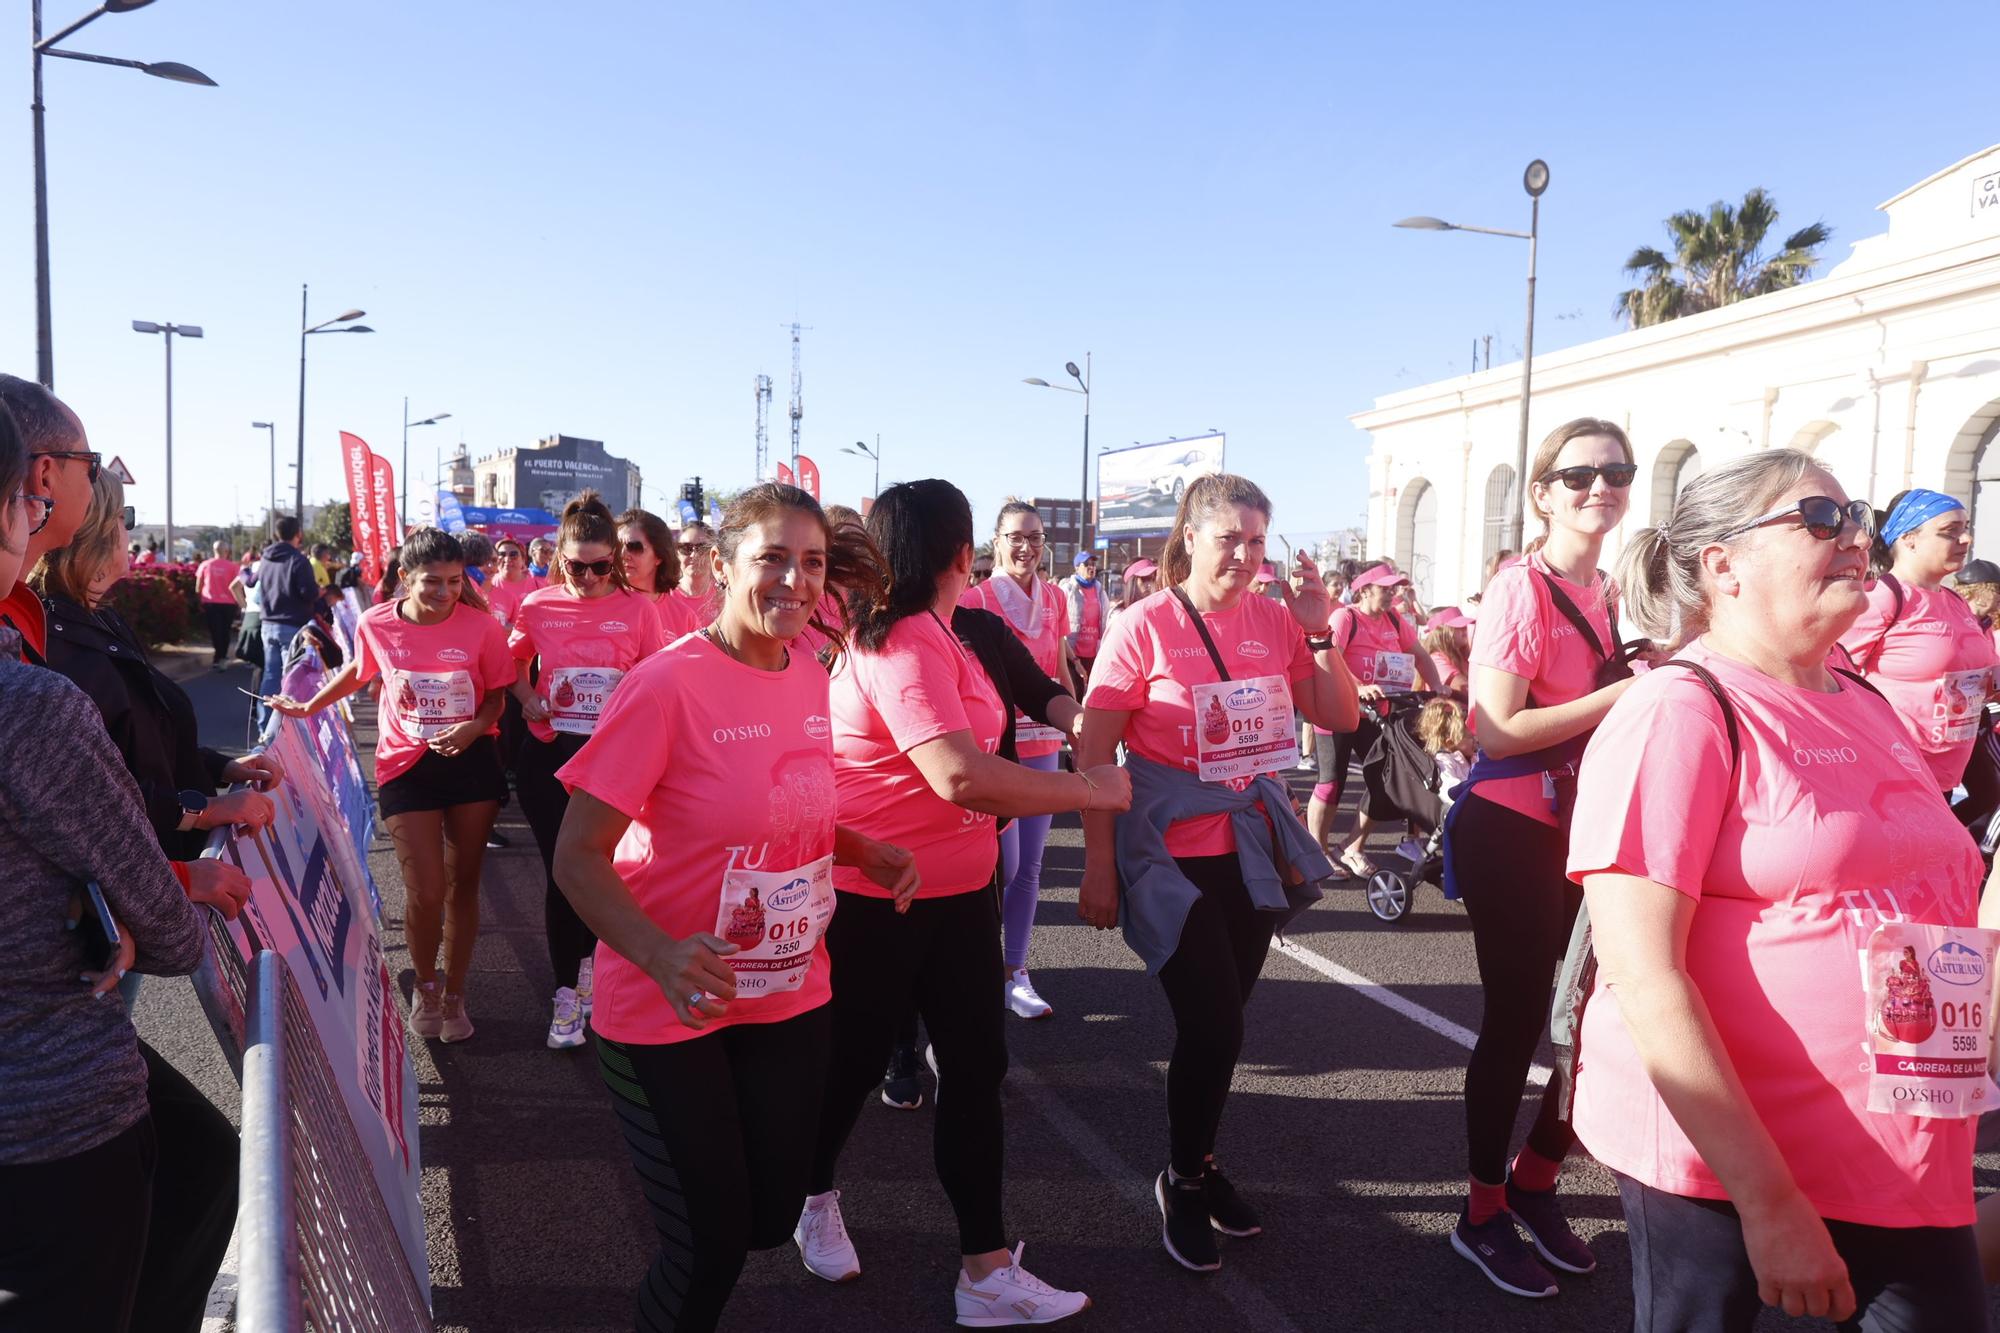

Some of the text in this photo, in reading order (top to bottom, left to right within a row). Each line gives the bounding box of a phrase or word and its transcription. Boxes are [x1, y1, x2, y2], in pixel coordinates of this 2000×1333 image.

[1983, 177, 2000, 192] G
[534, 460, 563, 469] PUERTO
[541, 620, 574, 629] OYSHO
[1551, 624, 1579, 639] OYSH
[1168, 647, 1208, 658] OYSHO
[419, 697, 447, 708] 016
[577, 693, 602, 704] 016
[581, 704, 597, 712] 5620
[1232, 716, 1264, 733] 016
[713, 723, 771, 743] OYSHO
[1238, 734, 1259, 745] 5599
[1212, 752, 1237, 760] CARRERA
[1793, 746, 1857, 766] OYSHO
[1209, 755, 1291, 775] OYSHO Santander
[725, 842, 769, 871] TU
[1838, 888, 1904, 928] TU
[768, 916, 809, 941] 016
[774, 940, 800, 955] 2550
[783, 960, 793, 968] LA
[1941, 1001, 1982, 1029] 016
[1952, 1035, 1977, 1051] 5598
[1897, 1061, 1952, 1073] CARRERA
[1953, 1063, 1964, 1073] DE
[1964, 1063, 1973, 1073] LA
[1893, 1086, 1954, 1104] OYSHO
